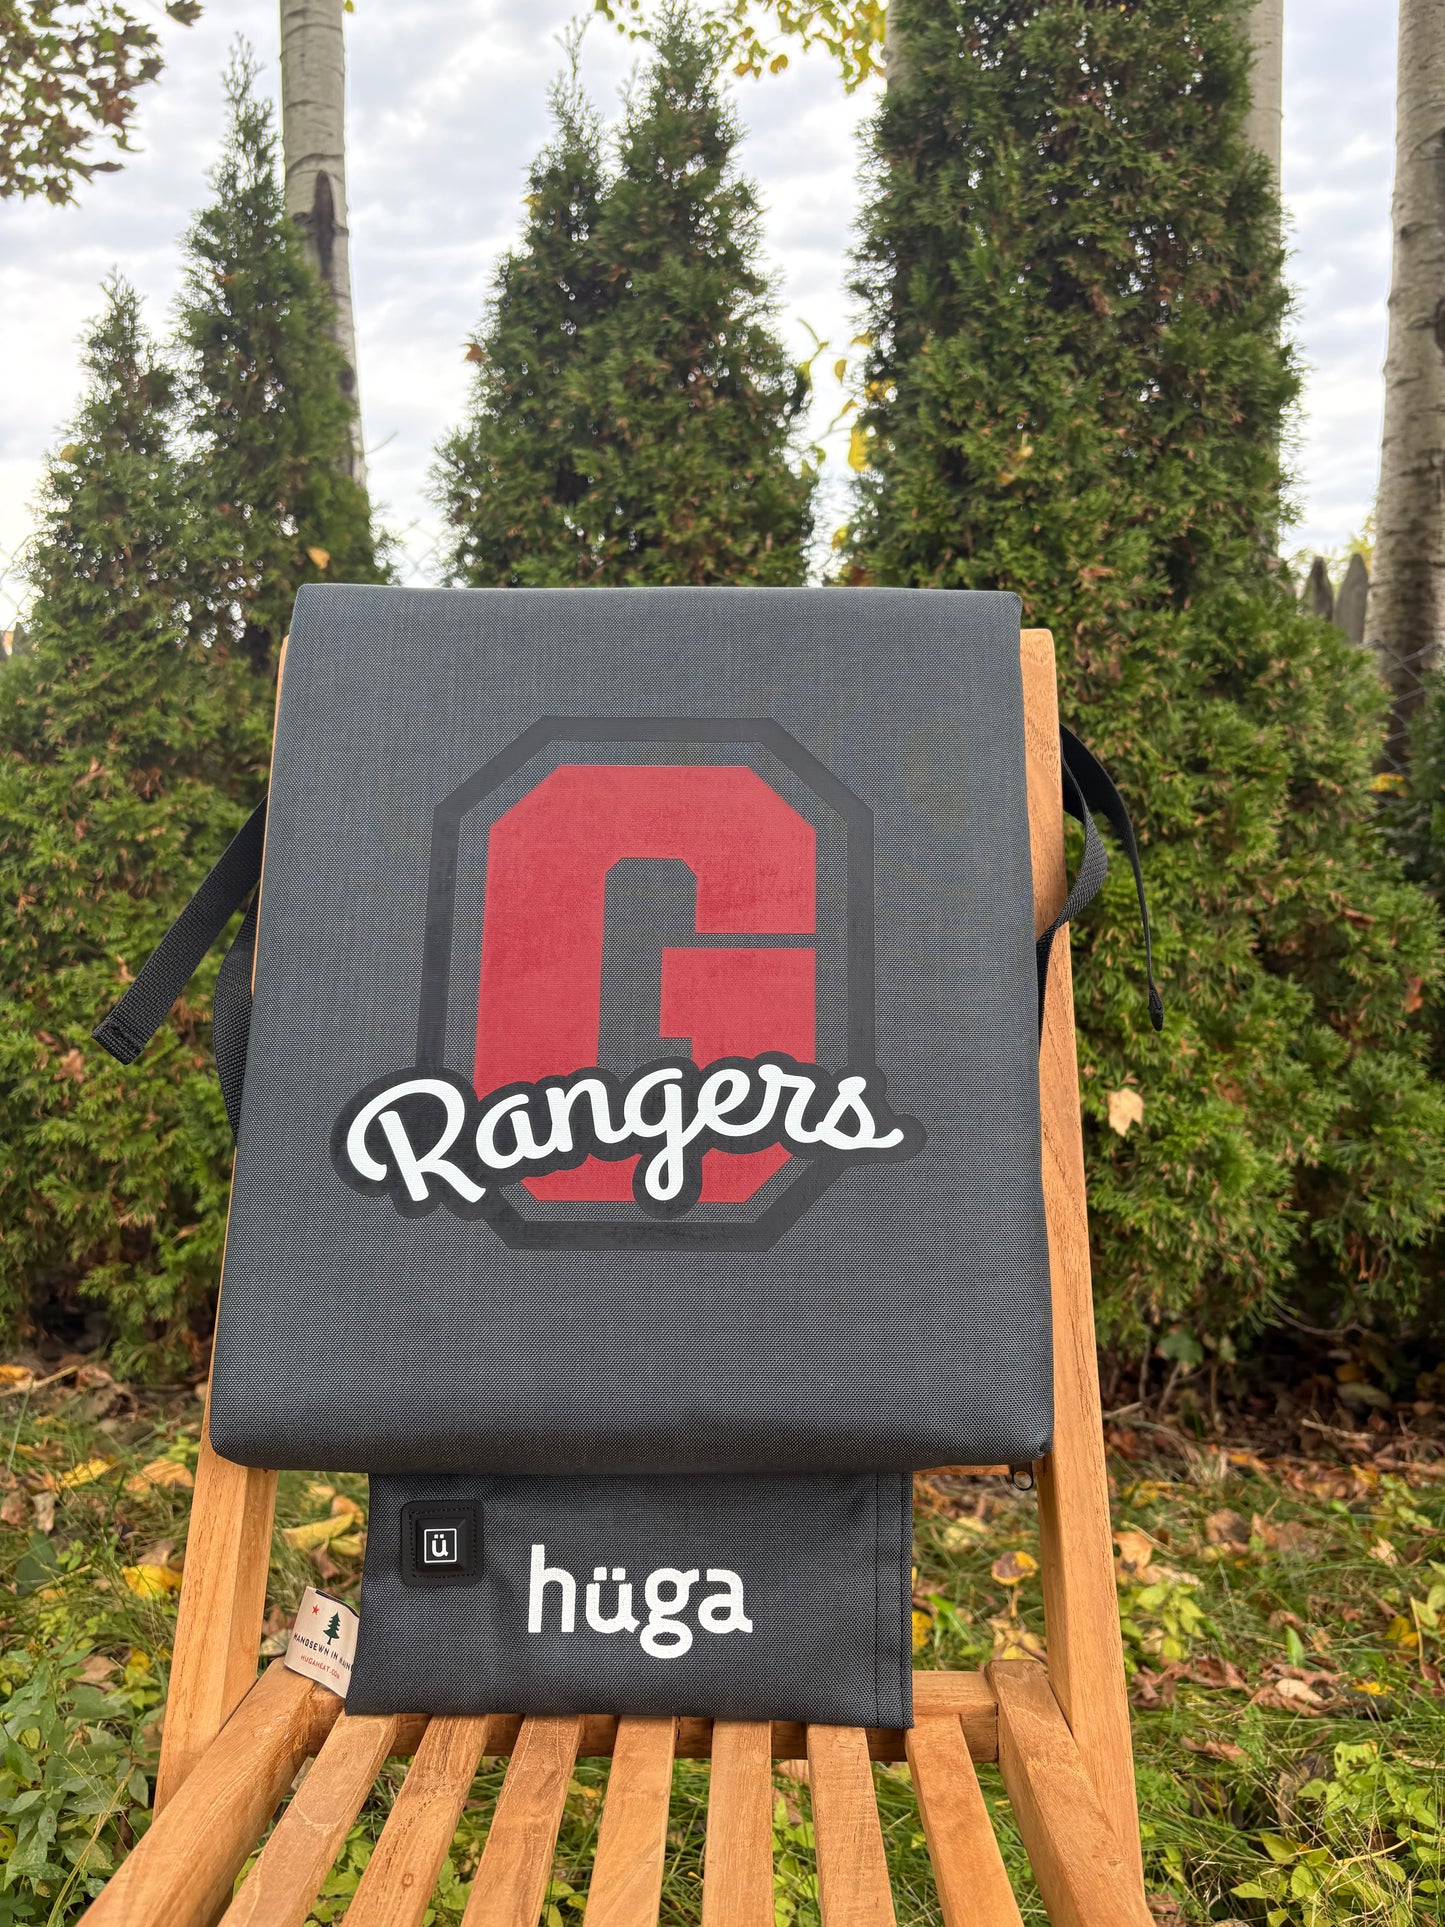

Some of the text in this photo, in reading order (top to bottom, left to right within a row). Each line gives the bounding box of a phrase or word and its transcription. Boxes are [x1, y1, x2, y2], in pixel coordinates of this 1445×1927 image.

[346, 1064, 905, 1204] Rangers
[430, 1533, 450, 1557] ü
[527, 1543, 753, 1659] hüga
[293, 1632, 352, 1671] HANDSEWN IN MAIN
